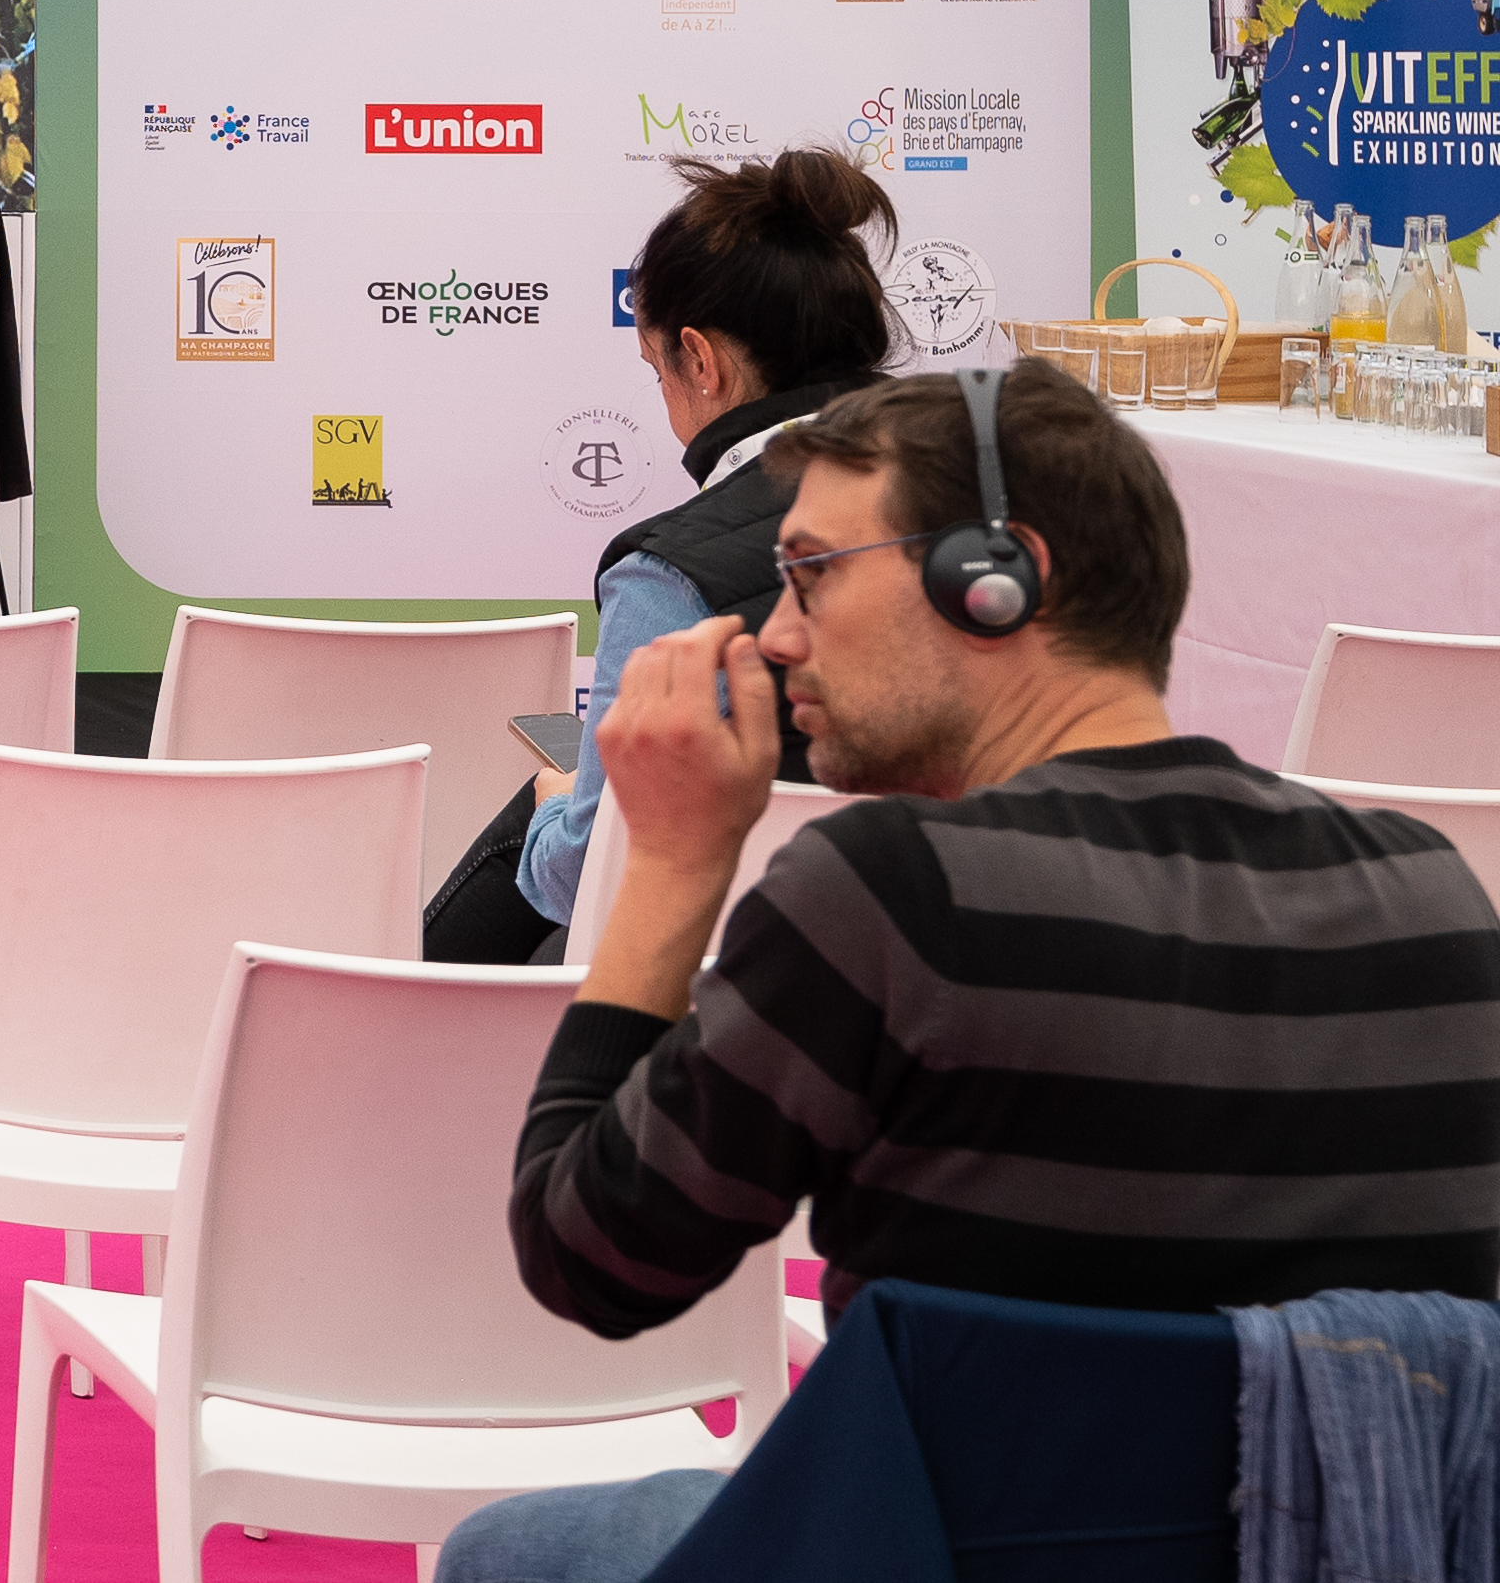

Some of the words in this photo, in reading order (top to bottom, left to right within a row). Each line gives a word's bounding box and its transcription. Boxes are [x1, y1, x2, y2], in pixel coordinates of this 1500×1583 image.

[1351, 51, 1500, 104] VITEFF
[905, 88, 966, 110] Mission
[971, 88, 1019, 110] Locale
[144, 115, 195, 124] RÉPUBLIQUE
[144, 125, 191, 134] FRANÇAISE
[258, 114, 309, 127] France
[903, 113, 925, 130] des
[929, 117, 958, 134] pays
[1353, 111, 1450, 134] SPARKLING
[1456, 112, 1500, 135] WINE
[257, 129, 308, 142] Travail
[903, 132, 929, 150] Brie
[933, 132, 944, 150] et
[948, 132, 1022, 153] Champagne
[909, 160, 937, 168] GRAND
[938, 160, 954, 168] EST
[1353, 141, 1500, 166] EXHIBITION
[383, 306, 417, 323] DE
[430, 306, 539, 324] FRANCE
[317, 419, 378, 444] SGV
[554, 408, 640, 436] TONNELLERIE
